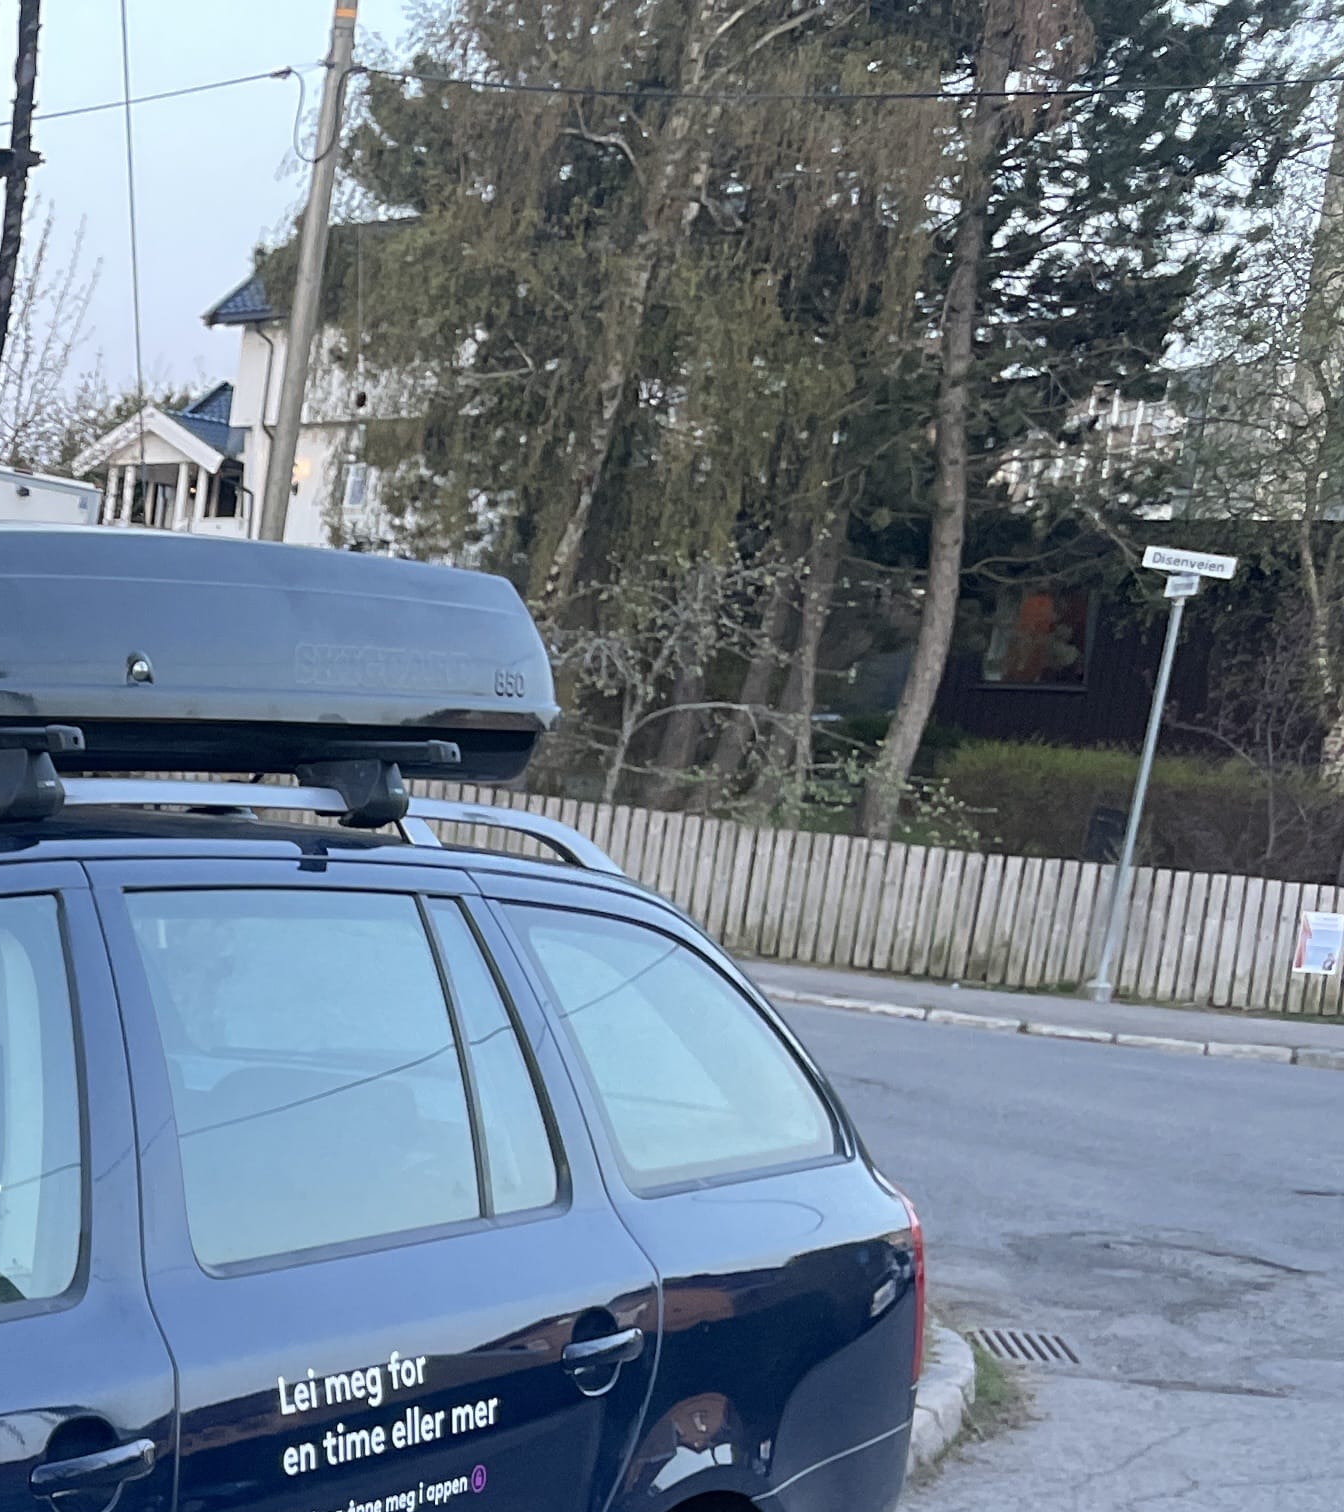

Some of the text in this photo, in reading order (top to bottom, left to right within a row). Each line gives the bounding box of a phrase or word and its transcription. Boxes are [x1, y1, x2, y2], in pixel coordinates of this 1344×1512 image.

[1152, 551, 1225, 572] Disenveien
[278, 1351, 426, 1415] Lei meg for
[283, 1397, 498, 1476] en time eller mer
[419, 1482, 424, 1504] i
[426, 1475, 468, 1506] appen
